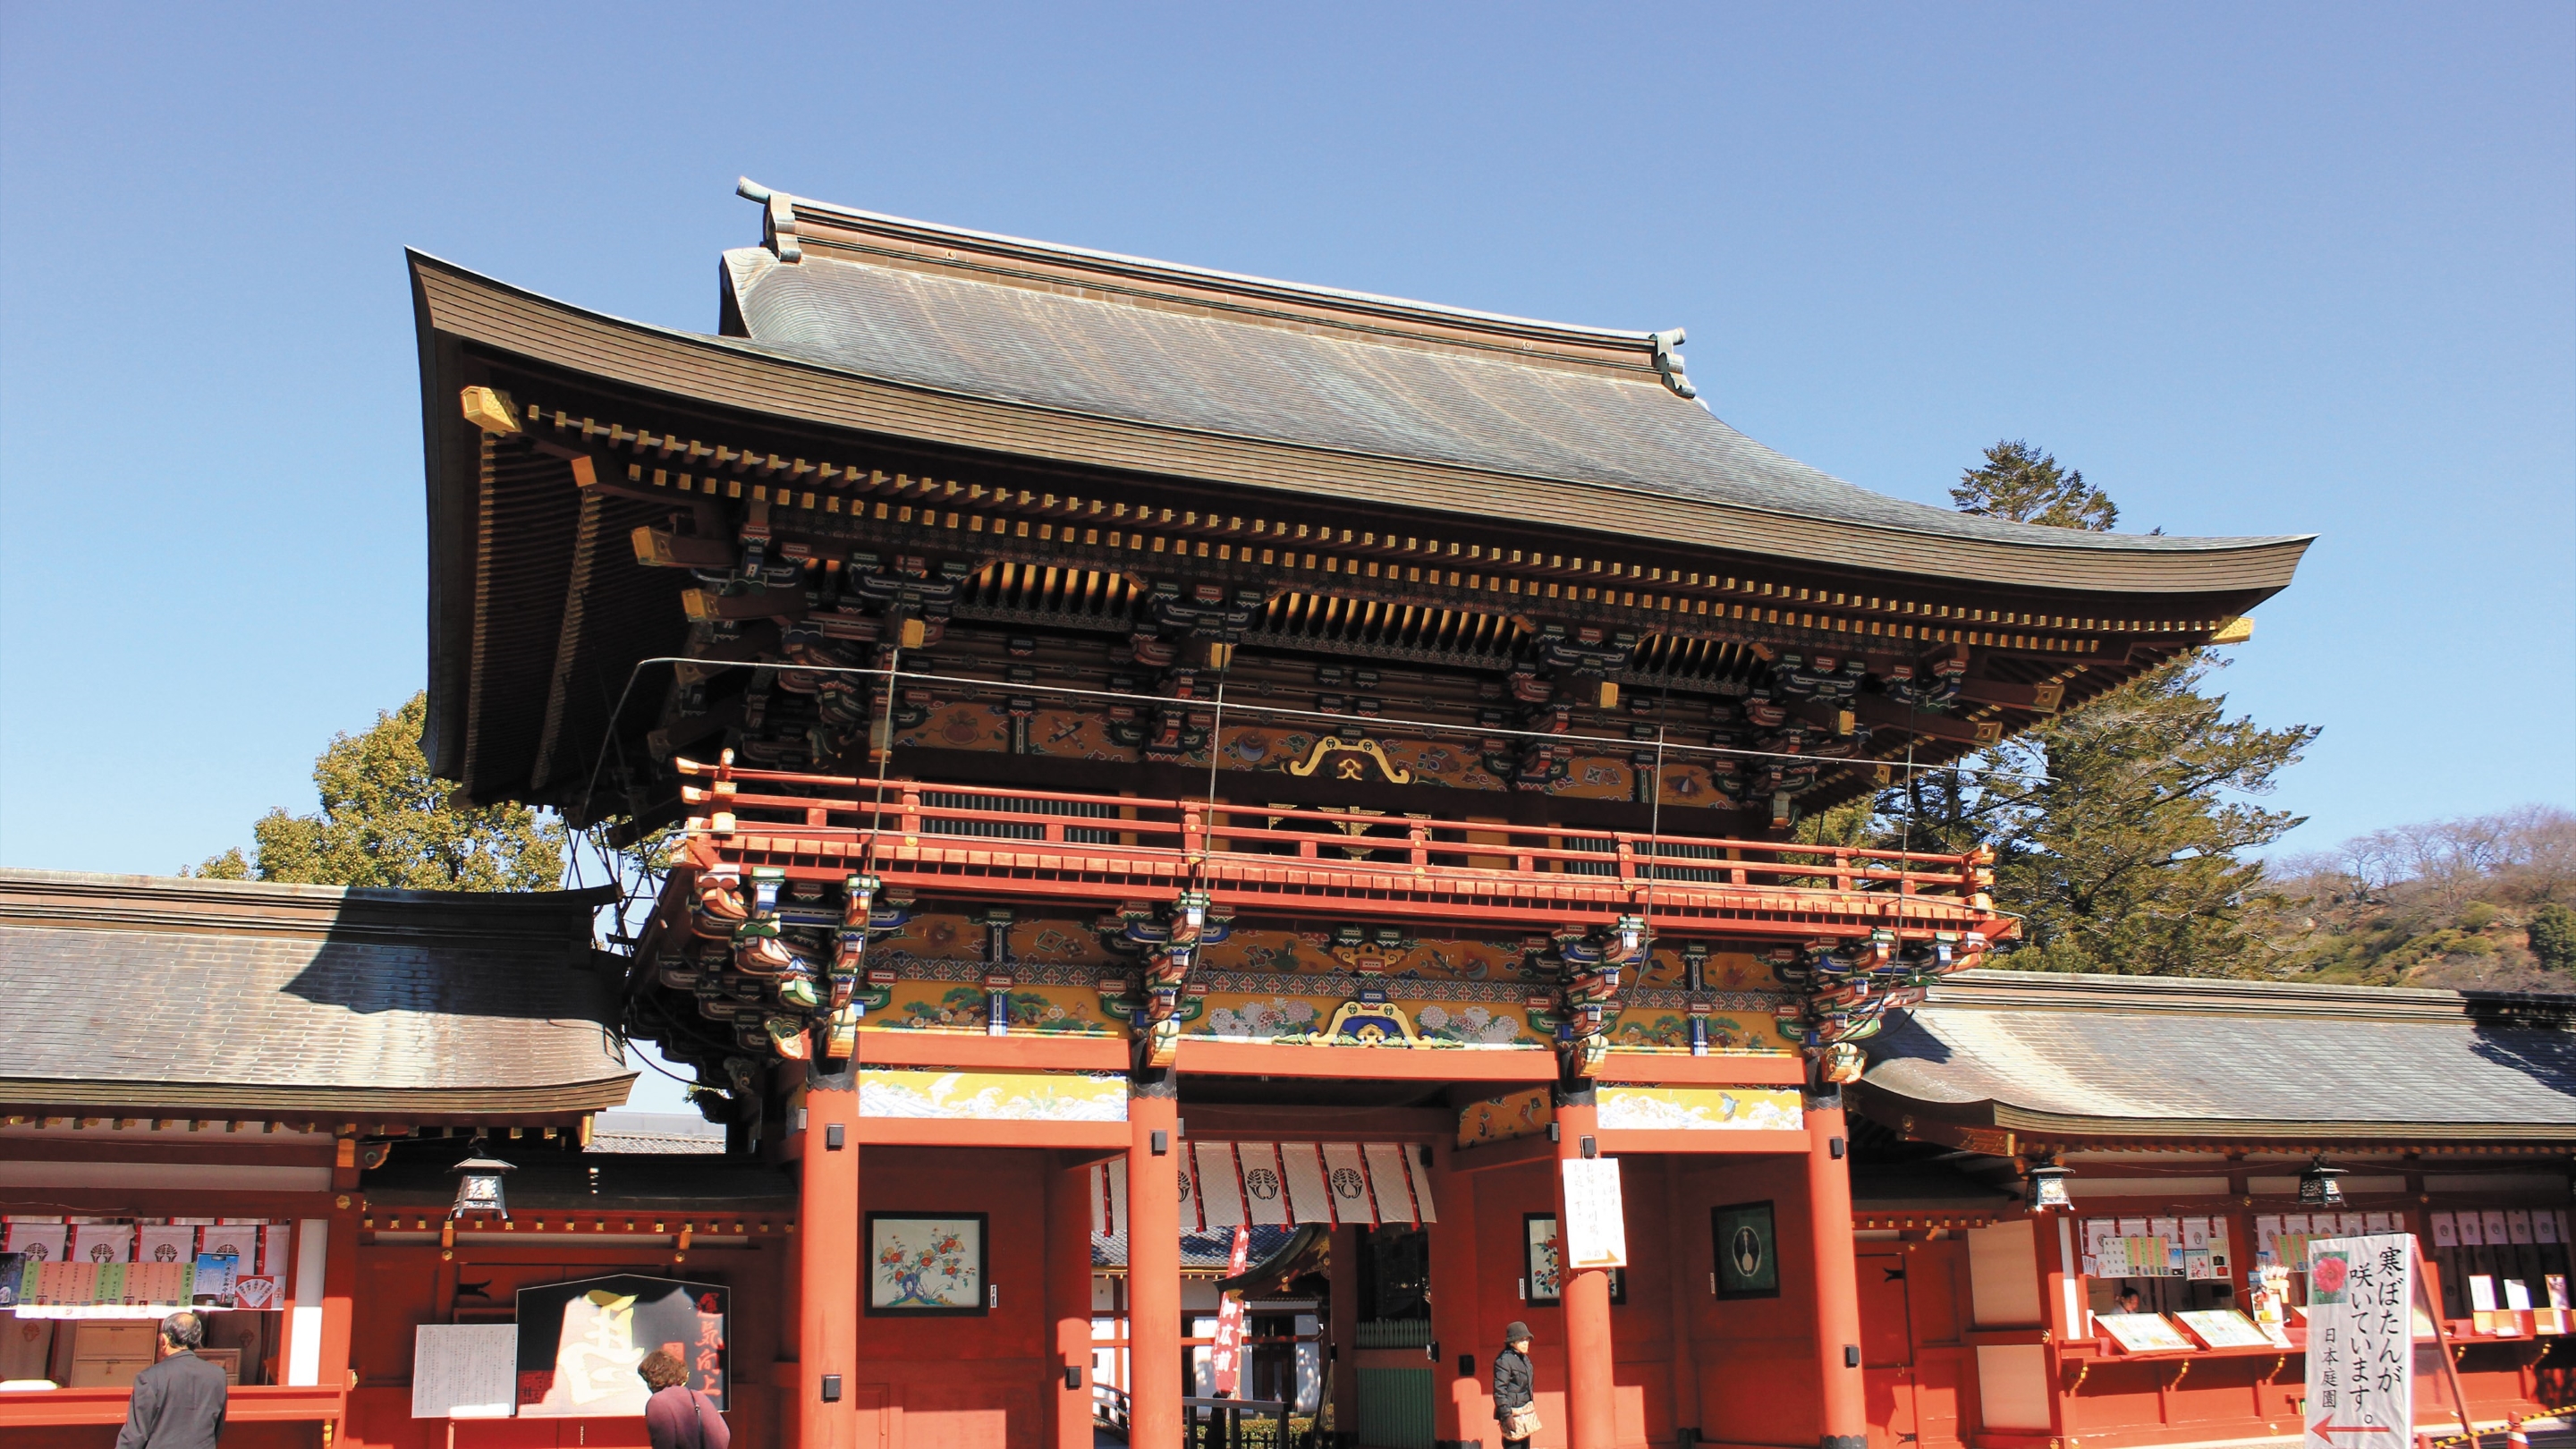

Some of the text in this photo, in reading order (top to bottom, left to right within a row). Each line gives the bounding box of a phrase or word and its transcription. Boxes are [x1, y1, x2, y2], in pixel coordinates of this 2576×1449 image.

[694, 1292, 725, 1397] 運気向上
[2320, 1327, 2340, 1409] 日本庭園
[2348, 1262, 2374, 1425] 咲いています。
[2377, 1246, 2405, 1394] 寒ぼたんが
